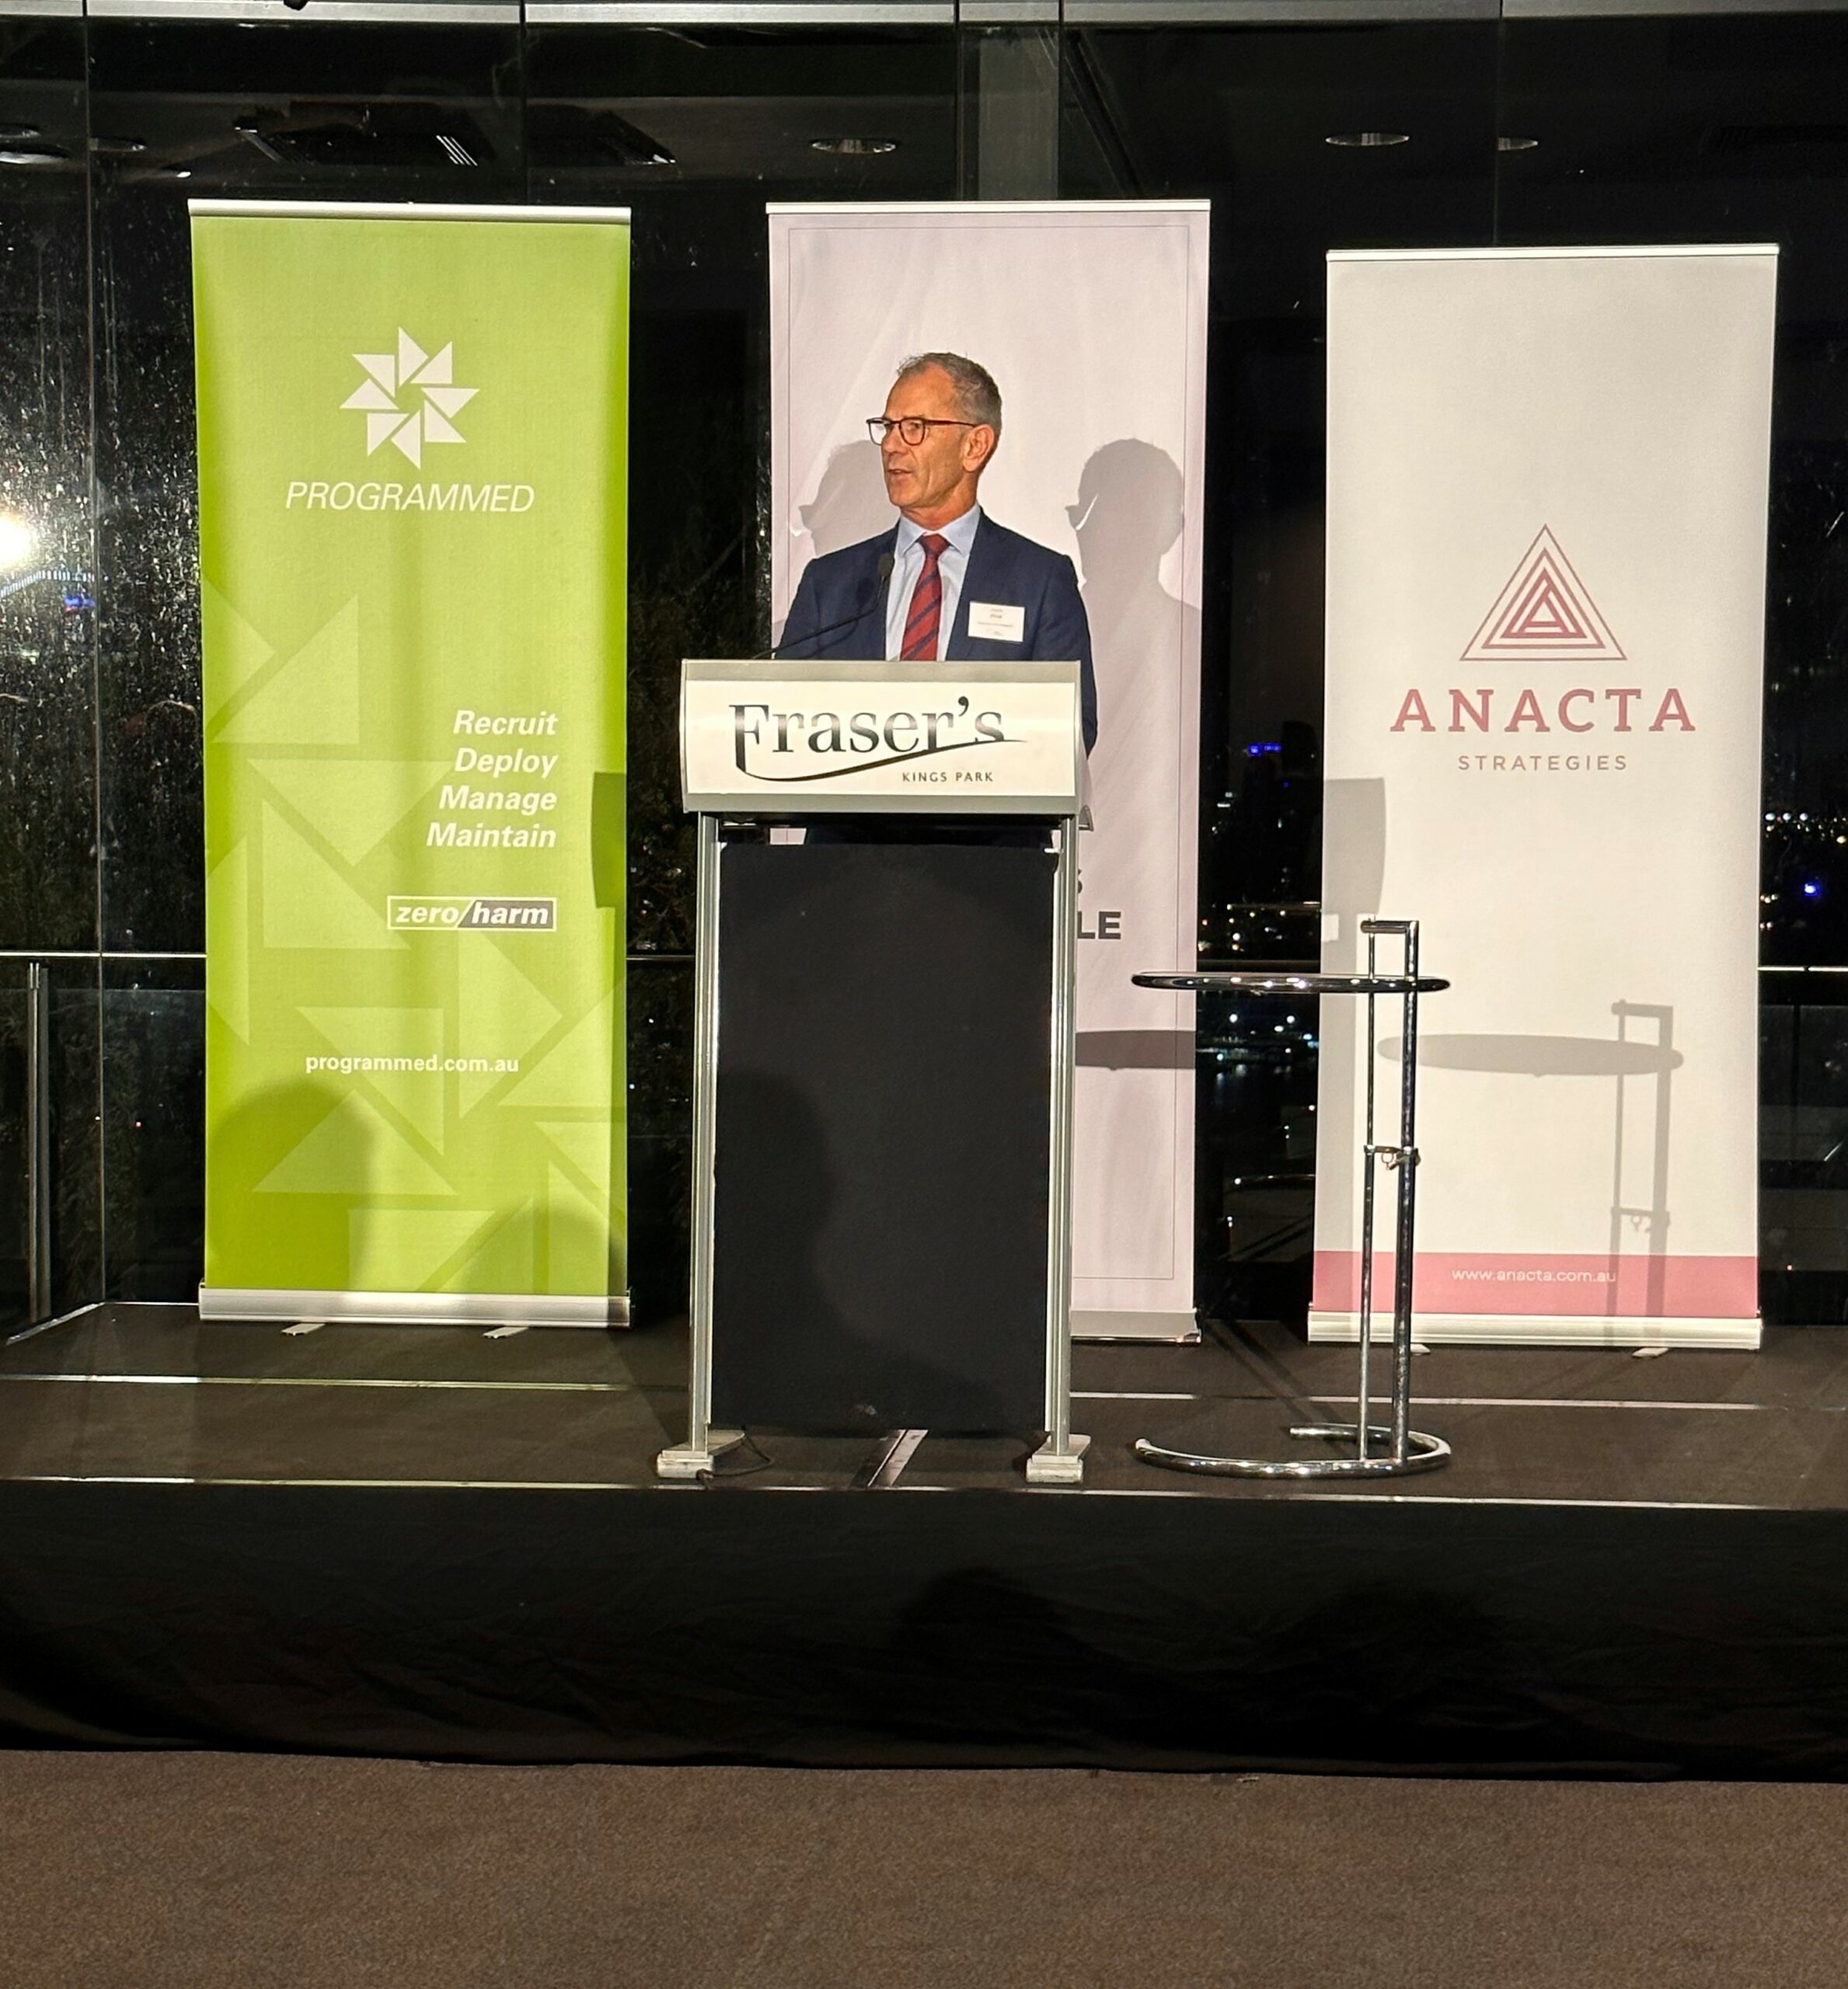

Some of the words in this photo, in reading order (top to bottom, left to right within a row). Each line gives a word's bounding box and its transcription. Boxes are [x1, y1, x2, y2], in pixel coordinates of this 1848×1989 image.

[285, 481, 535, 513] PROGRAMMED
[453, 709, 558, 735] Recruit
[1389, 688, 1696, 733] ANACTA
[729, 695, 1012, 779] Fraser's
[455, 747, 559, 779] Deploy
[1458, 754, 1627, 771] STRATEGIES
[902, 772, 947, 782] KINGS
[955, 772, 993, 782] PARK
[439, 785, 557, 816] Manage
[427, 821, 556, 849] Maintain
[305, 1054, 520, 1074] programmed.com.au
[1452, 1270, 1616, 1282] www.anacta.com.au
